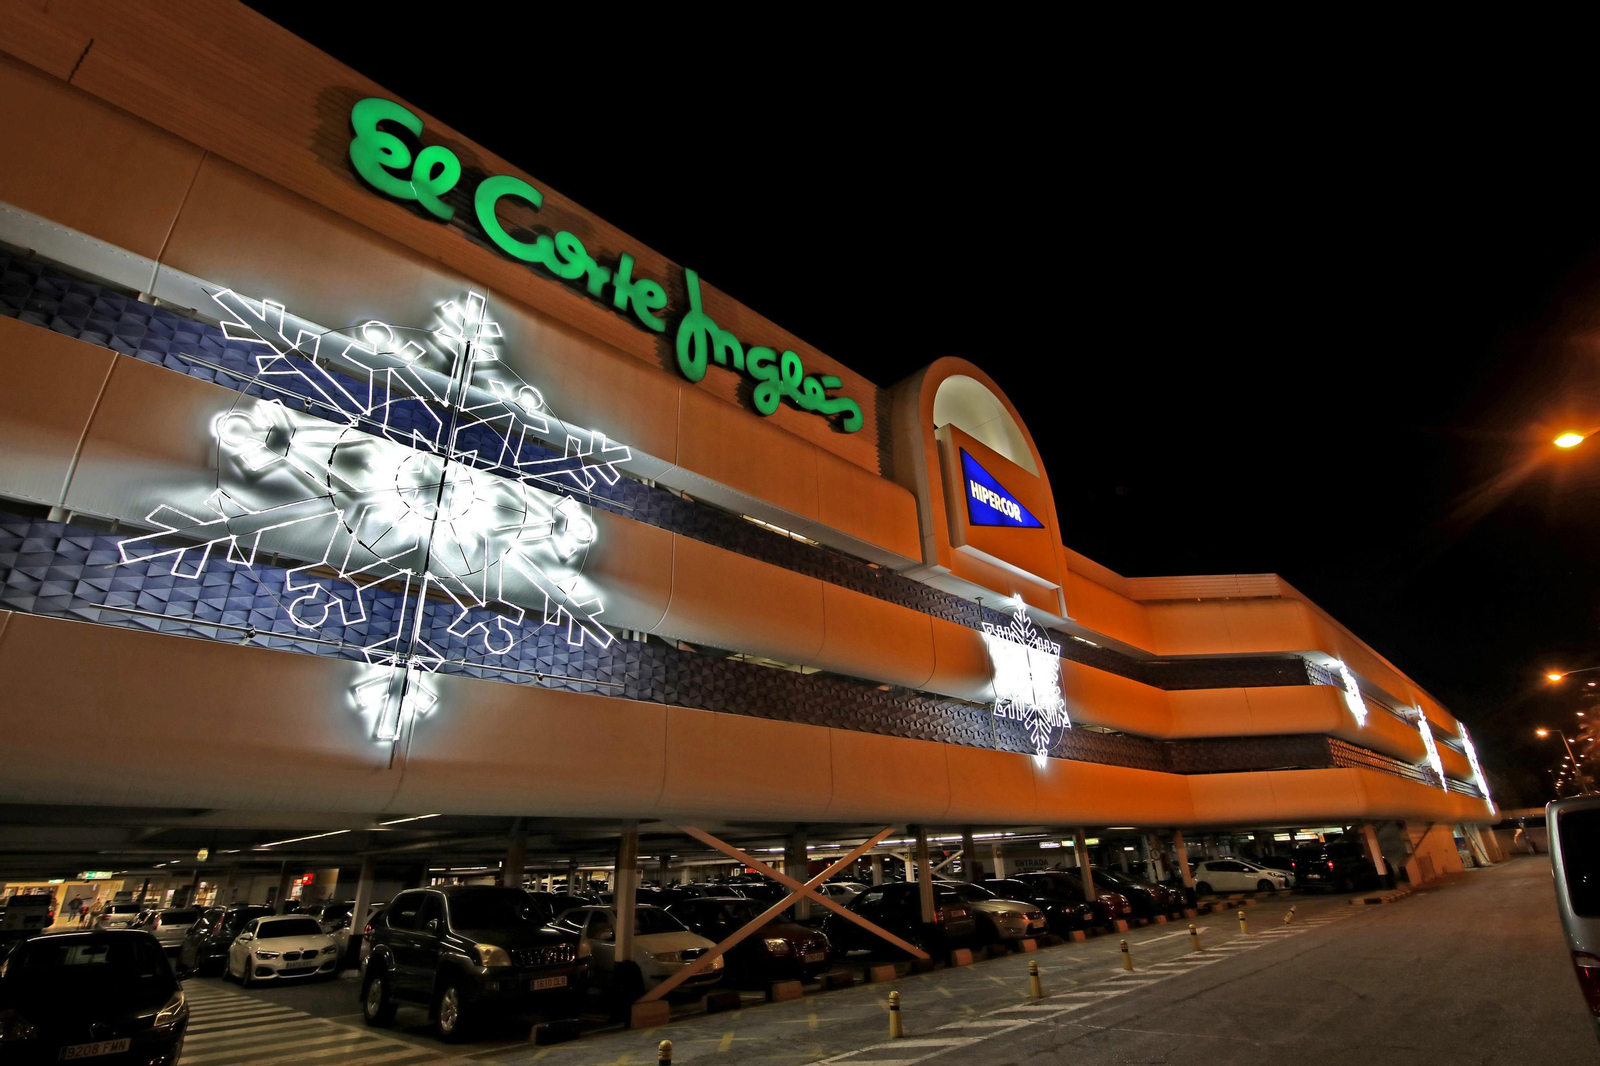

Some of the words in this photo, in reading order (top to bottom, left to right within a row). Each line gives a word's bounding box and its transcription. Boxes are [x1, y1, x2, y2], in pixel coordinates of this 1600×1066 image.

[350, 98, 462, 220] El
[474, 175, 668, 332] Corte
[676, 268, 863, 433] Inglés
[970, 479, 1022, 522] HIPERCOR
[1015, 859, 1048, 867] ENTRADA
[67, 1044, 100, 1058] 9208
